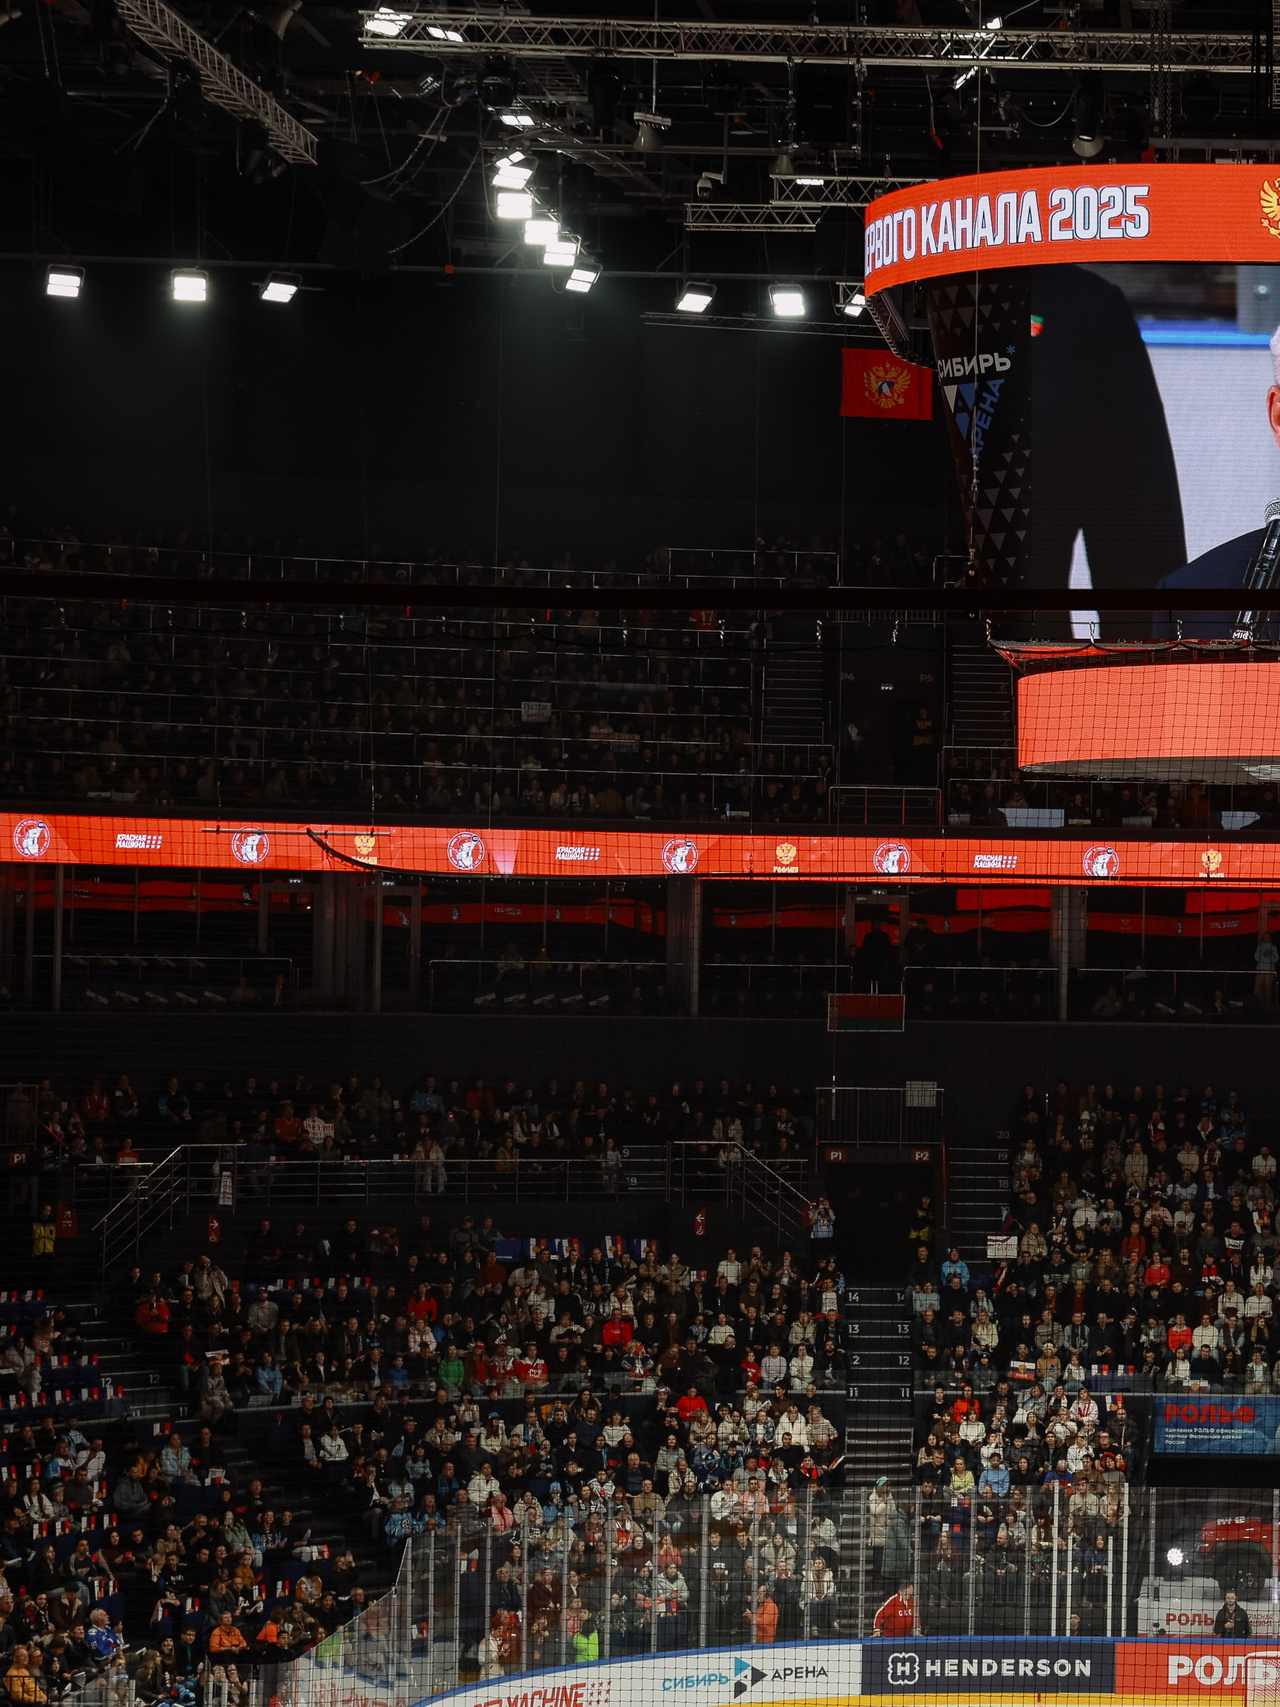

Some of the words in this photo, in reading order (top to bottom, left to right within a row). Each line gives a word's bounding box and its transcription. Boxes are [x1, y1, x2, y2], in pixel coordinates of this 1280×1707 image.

[865, 207, 916, 279] ЕРВОГО
[921, 189, 1044, 257] КАНАЛА
[1049, 185, 1151, 242] 2025
[937, 352, 1012, 379] СИБИРЬ
[830, 1151, 842, 1161] P1
[915, 1151, 930, 1161] P2
[848, 1292, 860, 1302] 14
[848, 1324, 860, 1334] 13
[897, 1324, 910, 1334] 13
[898, 1355, 910, 1366] 12
[849, 1387, 859, 1398] 11
[900, 1387, 910, 1398] 11
[1164, 1403, 1256, 1424] РОЛЬФ
[1165, 1612, 1215, 1627] РОЛЬ
[926, 1658, 1091, 1677] HENDERSON
[662, 1672, 730, 1692] СИБИРЬ
[771, 1665, 829, 1682] АРЕНА
